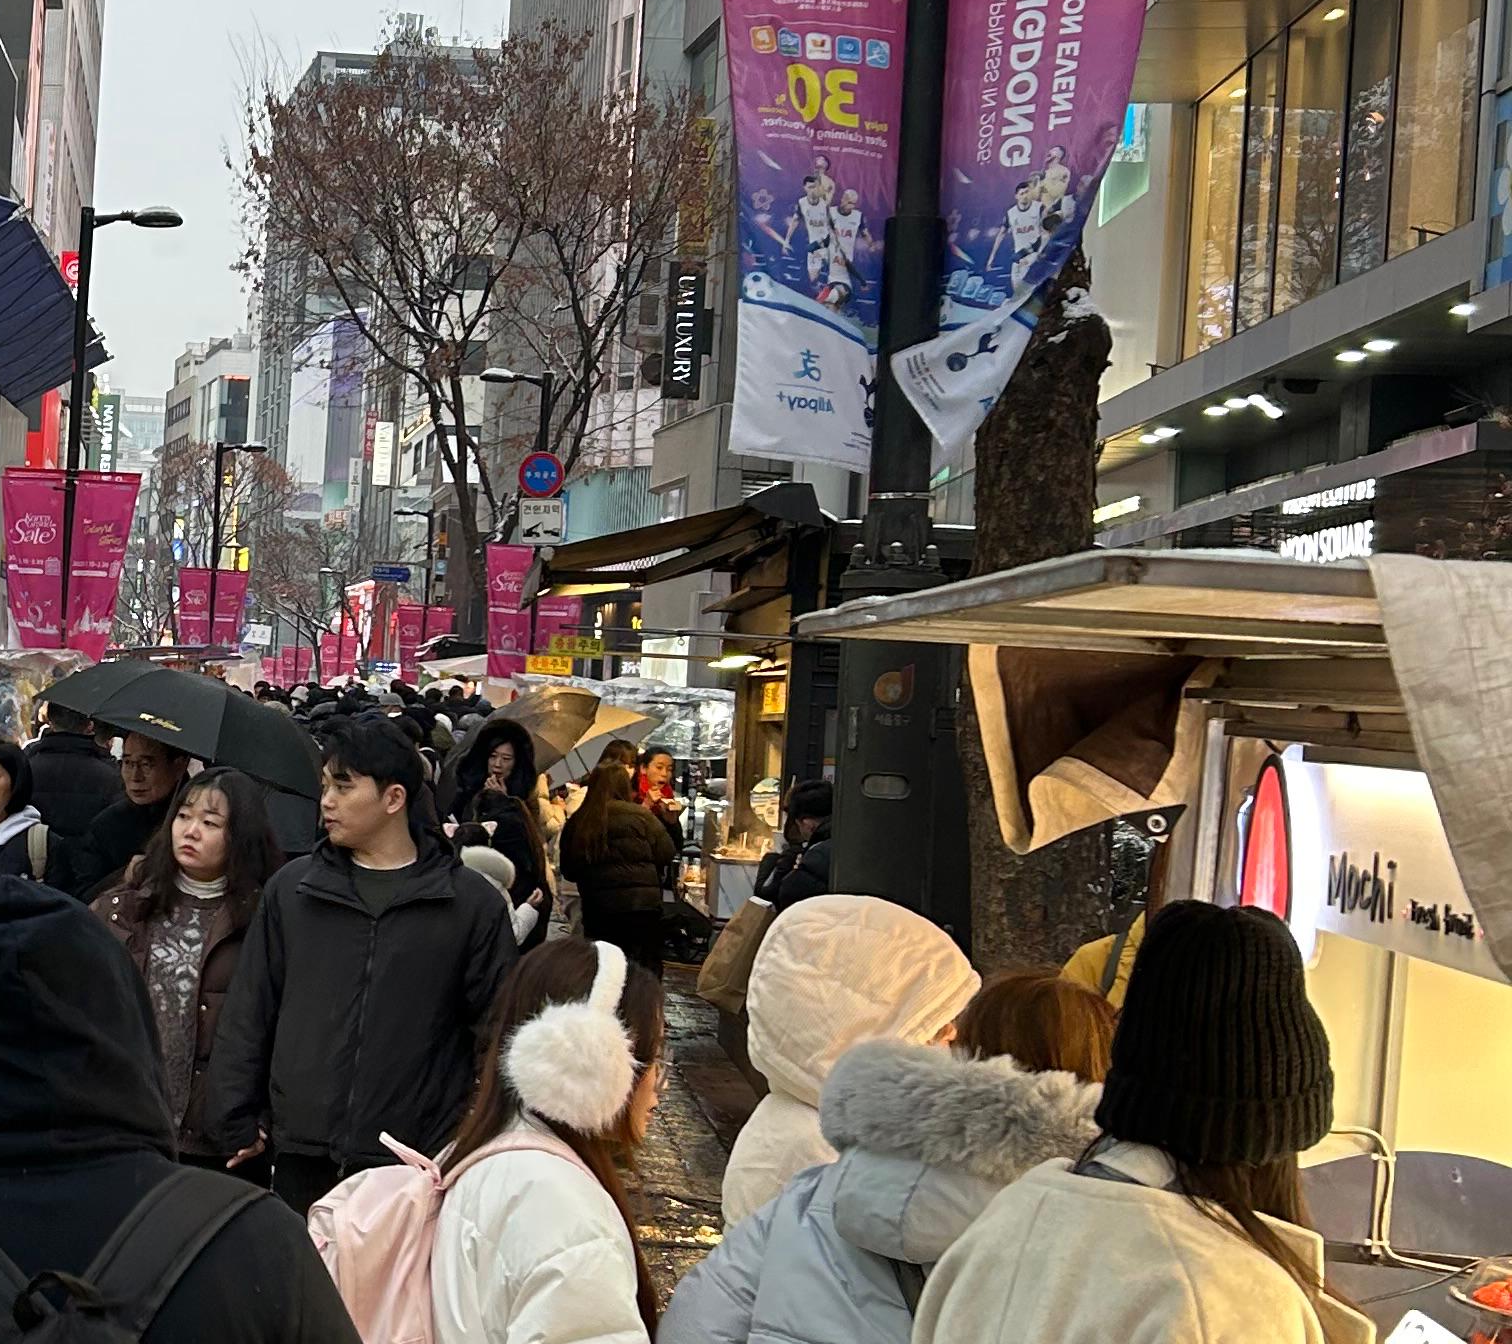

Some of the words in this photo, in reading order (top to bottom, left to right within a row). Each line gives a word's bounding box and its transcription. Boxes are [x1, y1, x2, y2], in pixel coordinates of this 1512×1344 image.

[672, 311, 695, 386] LUXURY
[11, 517, 57, 545] Sale
[523, 504, 561, 516] 견인지역
[1318, 519, 1374, 564] SQUARE
[1327, 850, 1398, 924] Mochi
